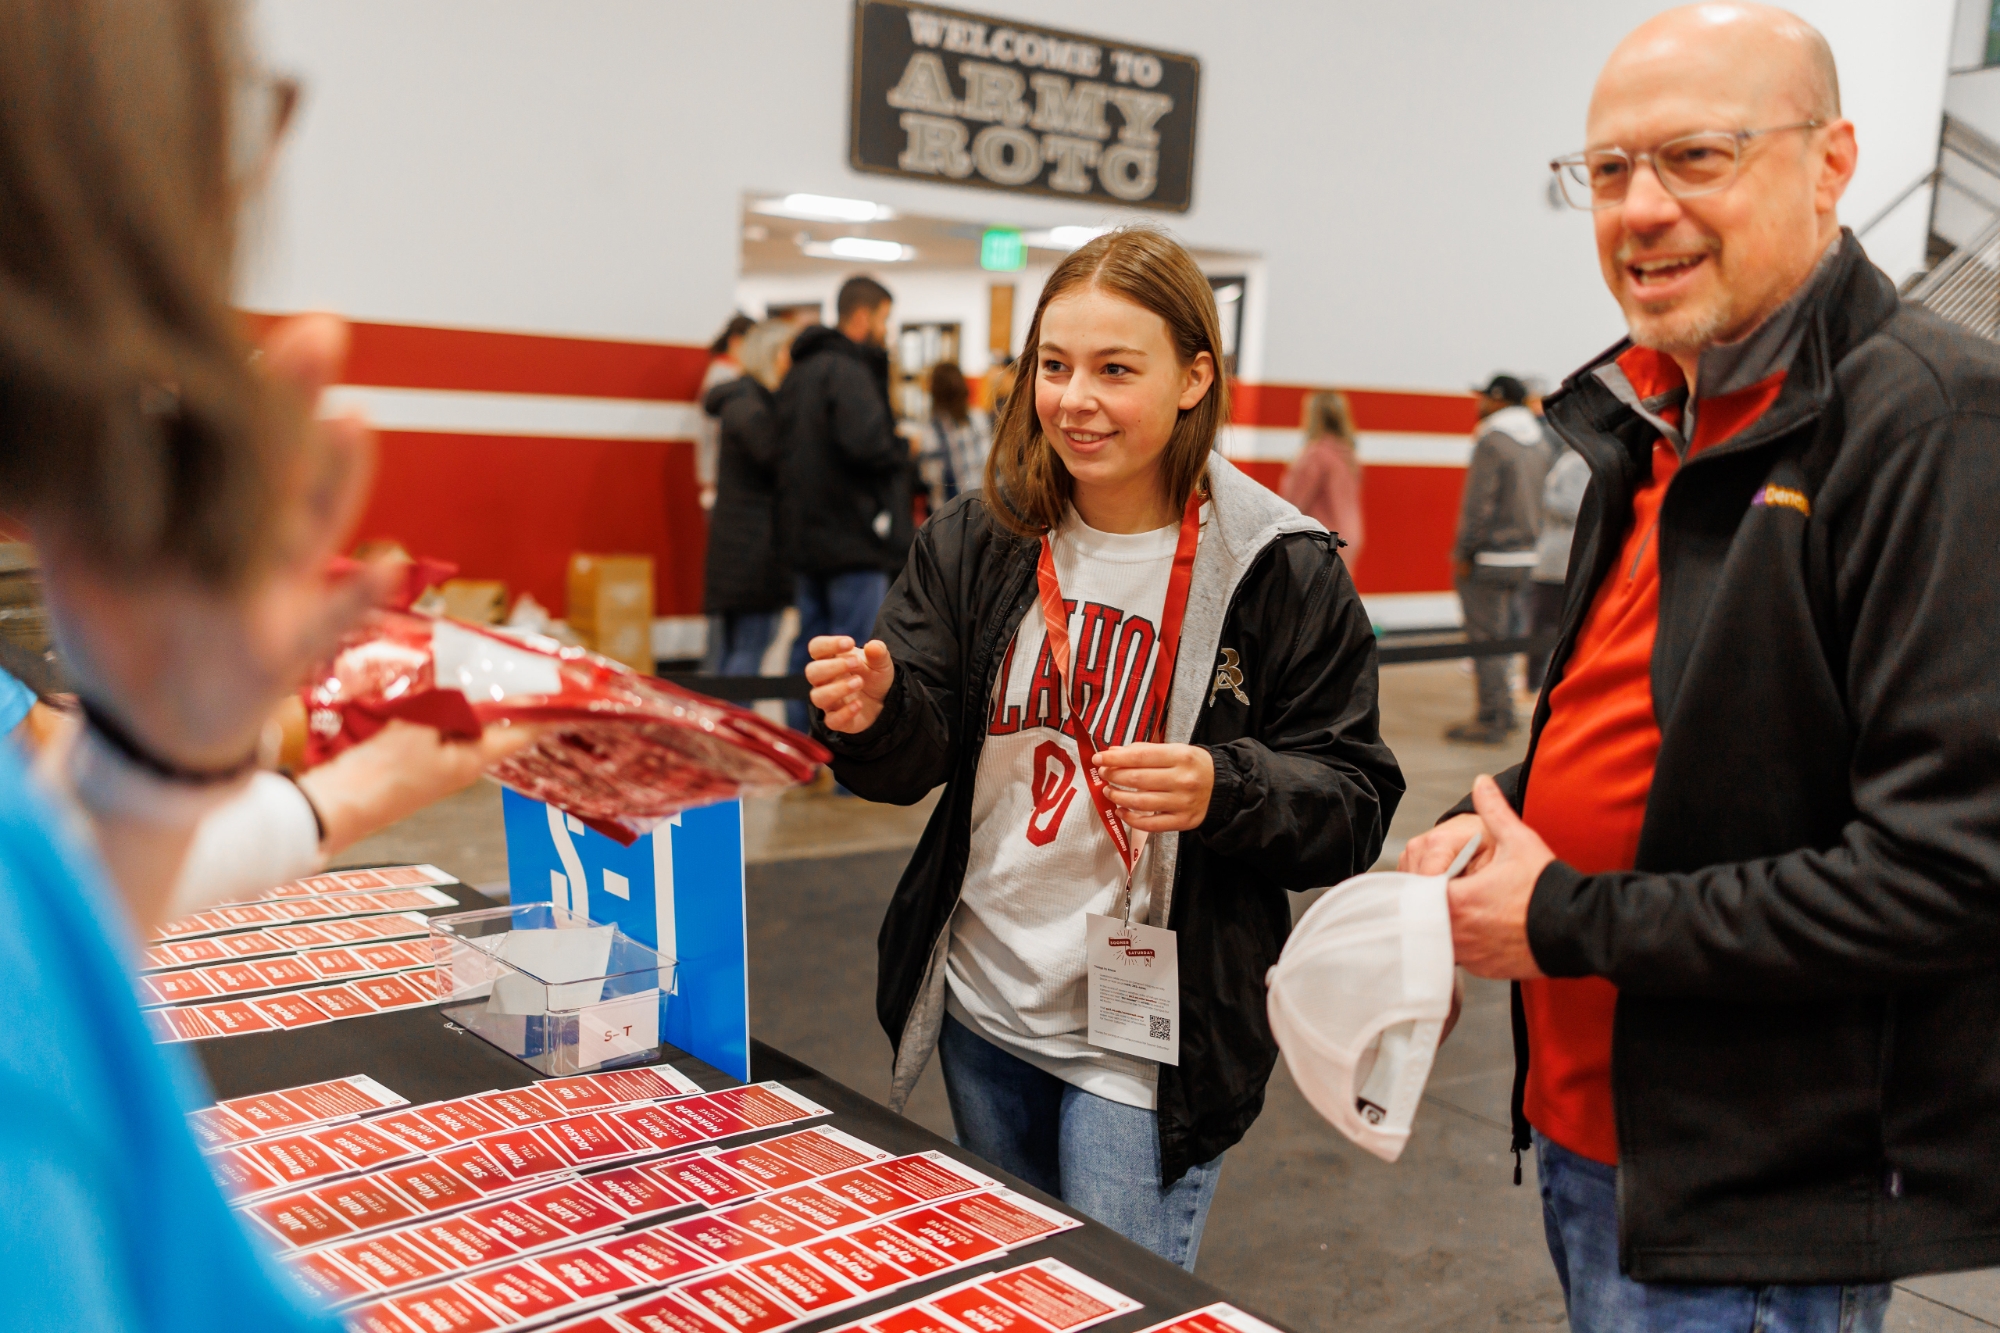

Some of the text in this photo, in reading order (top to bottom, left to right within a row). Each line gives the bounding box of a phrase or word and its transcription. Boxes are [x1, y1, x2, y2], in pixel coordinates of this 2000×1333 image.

[908, 11, 1163, 87] WELCOME TO
[887, 52, 1174, 145] ARMY
[899, 112, 1160, 200] ROTC
[246, 1108, 271, 1121] Jack
[444, 1106, 487, 1132] SUNDERLAND
[493, 1097, 531, 1121] Bethany
[675, 1105, 723, 1133] Makenzie
[698, 1108, 723, 1123] STONE
[391, 1121, 436, 1145] Heather
[417, 1123, 436, 1134] SUN
[435, 1113, 465, 1132] Toben
[637, 1118, 668, 1139] Sierra
[645, 1111, 687, 1139] STOCKINGER
[334, 1137, 367, 1157] Tessa
[344, 1130, 388, 1155] SUMMERLIN
[560, 1123, 594, 1151] Jackson
[582, 1128, 600, 1143] STIPE
[268, 1145, 306, 1176] Brannon
[495, 1143, 527, 1169] Tommy
[518, 1144, 536, 1159] STILL
[462, 1161, 488, 1178] Sam
[473, 1155, 505, 1177] STEWART
[736, 1158, 777, 1179] Emma
[406, 1177, 440, 1199] Kiana
[421, 1172, 456, 1195] STEWART
[622, 1180, 651, 1199] STEELE
[678, 1170, 720, 1196] Natalie
[687, 1163, 739, 1195] STEINHAUSER
[852, 1178, 894, 1201] SPRADLIN
[351, 1190, 387, 1214] STEWART
[841, 1184, 879, 1205] Ethan
[292, 1205, 327, 1230] STEWART
[545, 1201, 582, 1223] Lizzie
[560, 1197, 596, 1218] STAVISH
[780, 1196, 838, 1226] Elizabeth
[278, 1212, 307, 1231] Julia
[491, 1217, 527, 1237] Isaac
[749, 1218, 780, 1234] Kyle
[760, 1213, 796, 1232] SPOTTS
[430, 1226, 484, 1261] Catherine
[457, 1228, 491, 1250] STANZEL
[696, 1233, 727, 1249] Kyle
[707, 1227, 743, 1246] SPOTTS
[919, 1227, 957, 1247] Nour
[622, 1248, 664, 1271] Reese
[875, 1239, 917, 1264] Rylee
[358, 1250, 399, 1277] Kenzie
[823, 1248, 875, 1282] Clayton
[760, 1264, 819, 1303] Matthew
[781, 1263, 827, 1295] SOLOMON
